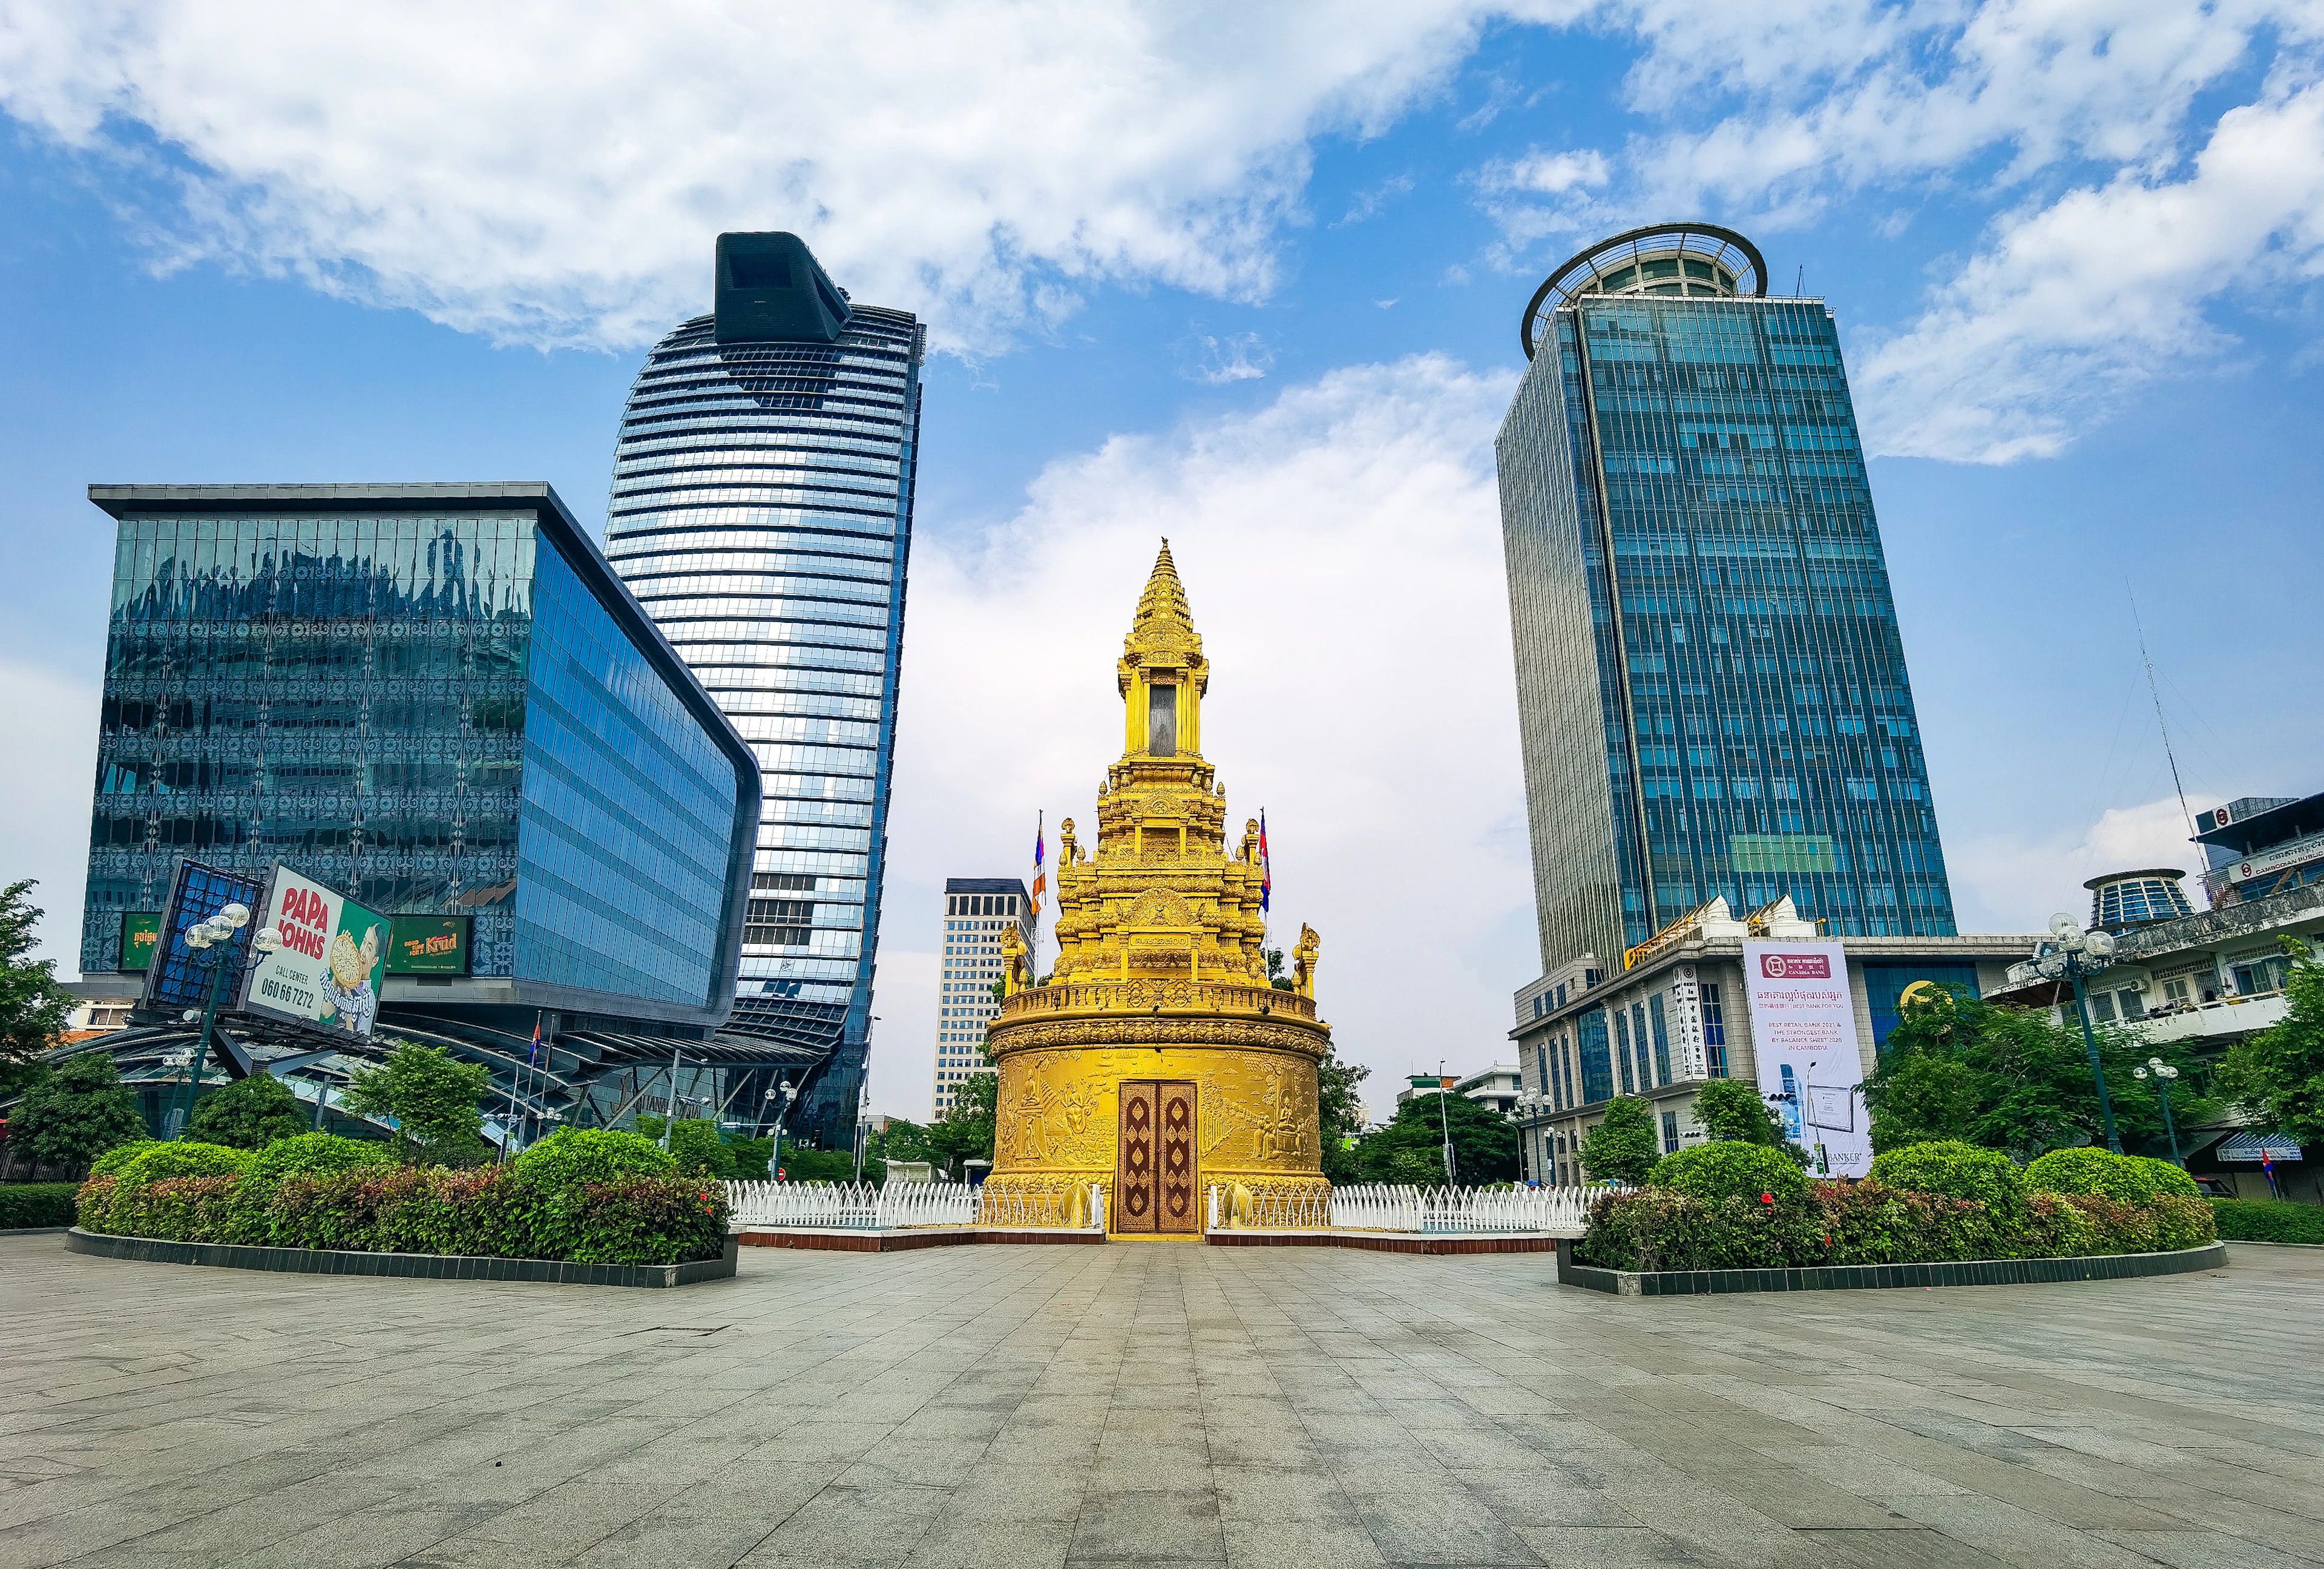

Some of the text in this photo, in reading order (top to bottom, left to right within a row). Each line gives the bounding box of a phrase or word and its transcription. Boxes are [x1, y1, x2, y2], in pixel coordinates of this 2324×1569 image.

[2256, 850, 2324, 875] CAMBODIAN PUBLIC
[281, 887, 328, 934] PAPA
[278, 919, 326, 960] JOHNS
[425, 933, 457, 954] Krud
[275, 965, 309, 985] CALL CENTER
[261, 978, 315, 1009] 060 66 7272
[1828, 1153, 1860, 1162] BANKER
